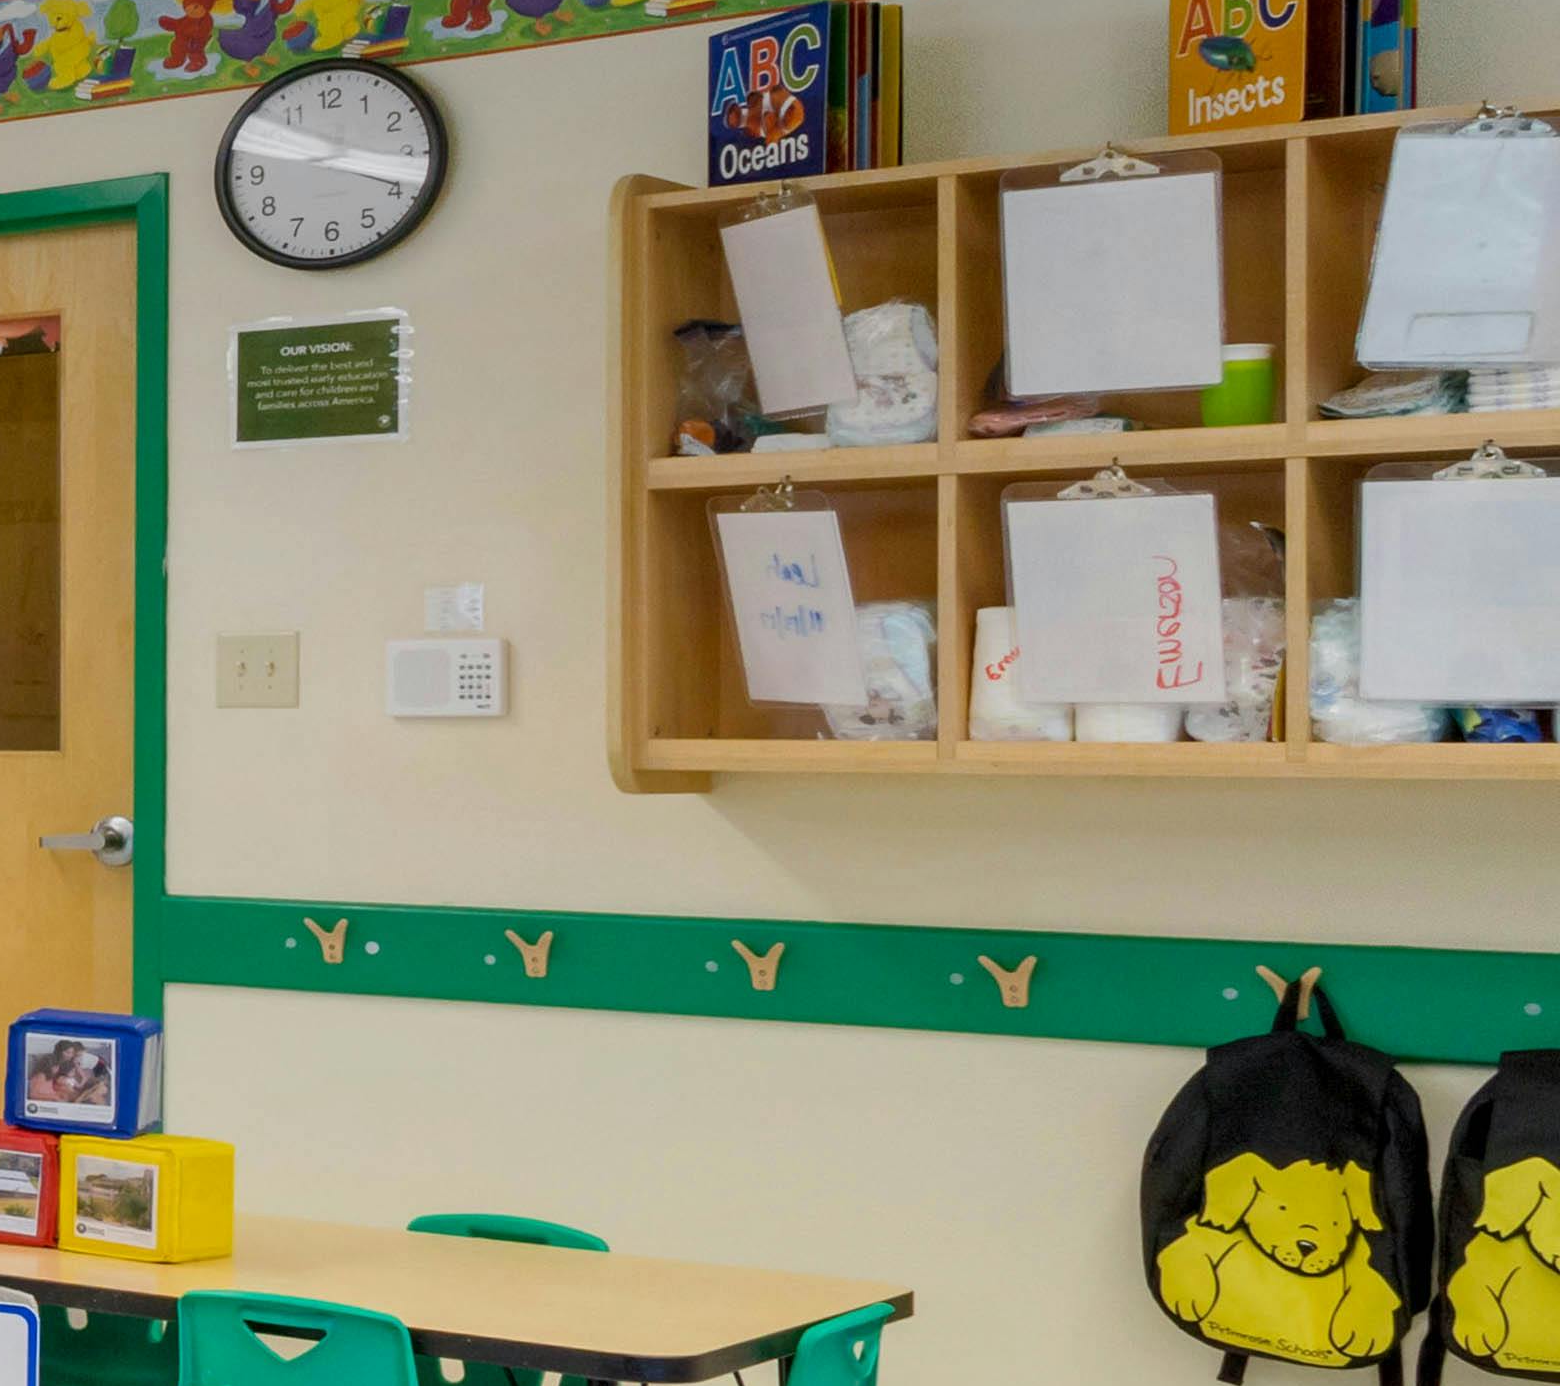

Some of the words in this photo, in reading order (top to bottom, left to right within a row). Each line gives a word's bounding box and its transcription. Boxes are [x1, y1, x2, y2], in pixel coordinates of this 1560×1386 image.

[711, 22, 821, 117] ABC
[318, 88, 343, 109] 12
[360, 95, 369, 114] 1
[1187, 75, 1286, 126] Insects
[285, 104, 304, 126] 11
[386, 111, 402, 133] 2
[720, 133, 810, 180] Oceans
[250, 165, 265, 186] 9
[387, 180, 403, 200] 4
[261, 196, 276, 216] 8
[290, 217, 305, 238] 7
[360, 208, 376, 229] 5
[324, 221, 340, 242] 6
[280, 345, 307, 357] OUR
[260, 365, 273, 375] To
[274, 363, 309, 374] deliver
[311, 361, 328, 371] the
[330, 359, 352, 370] best
[354, 358, 374, 368] and
[247, 378, 271, 388] most
[311, 373, 335, 386] early
[337, 370, 388, 382] education
[255, 389, 274, 400] and
[276, 388, 298, 398] care
[300, 386, 314, 397] for
[316, 384, 358, 396] children
[359, 382, 380, 393] and
[257, 399, 296, 411] families
[297, 398, 329, 409] across
